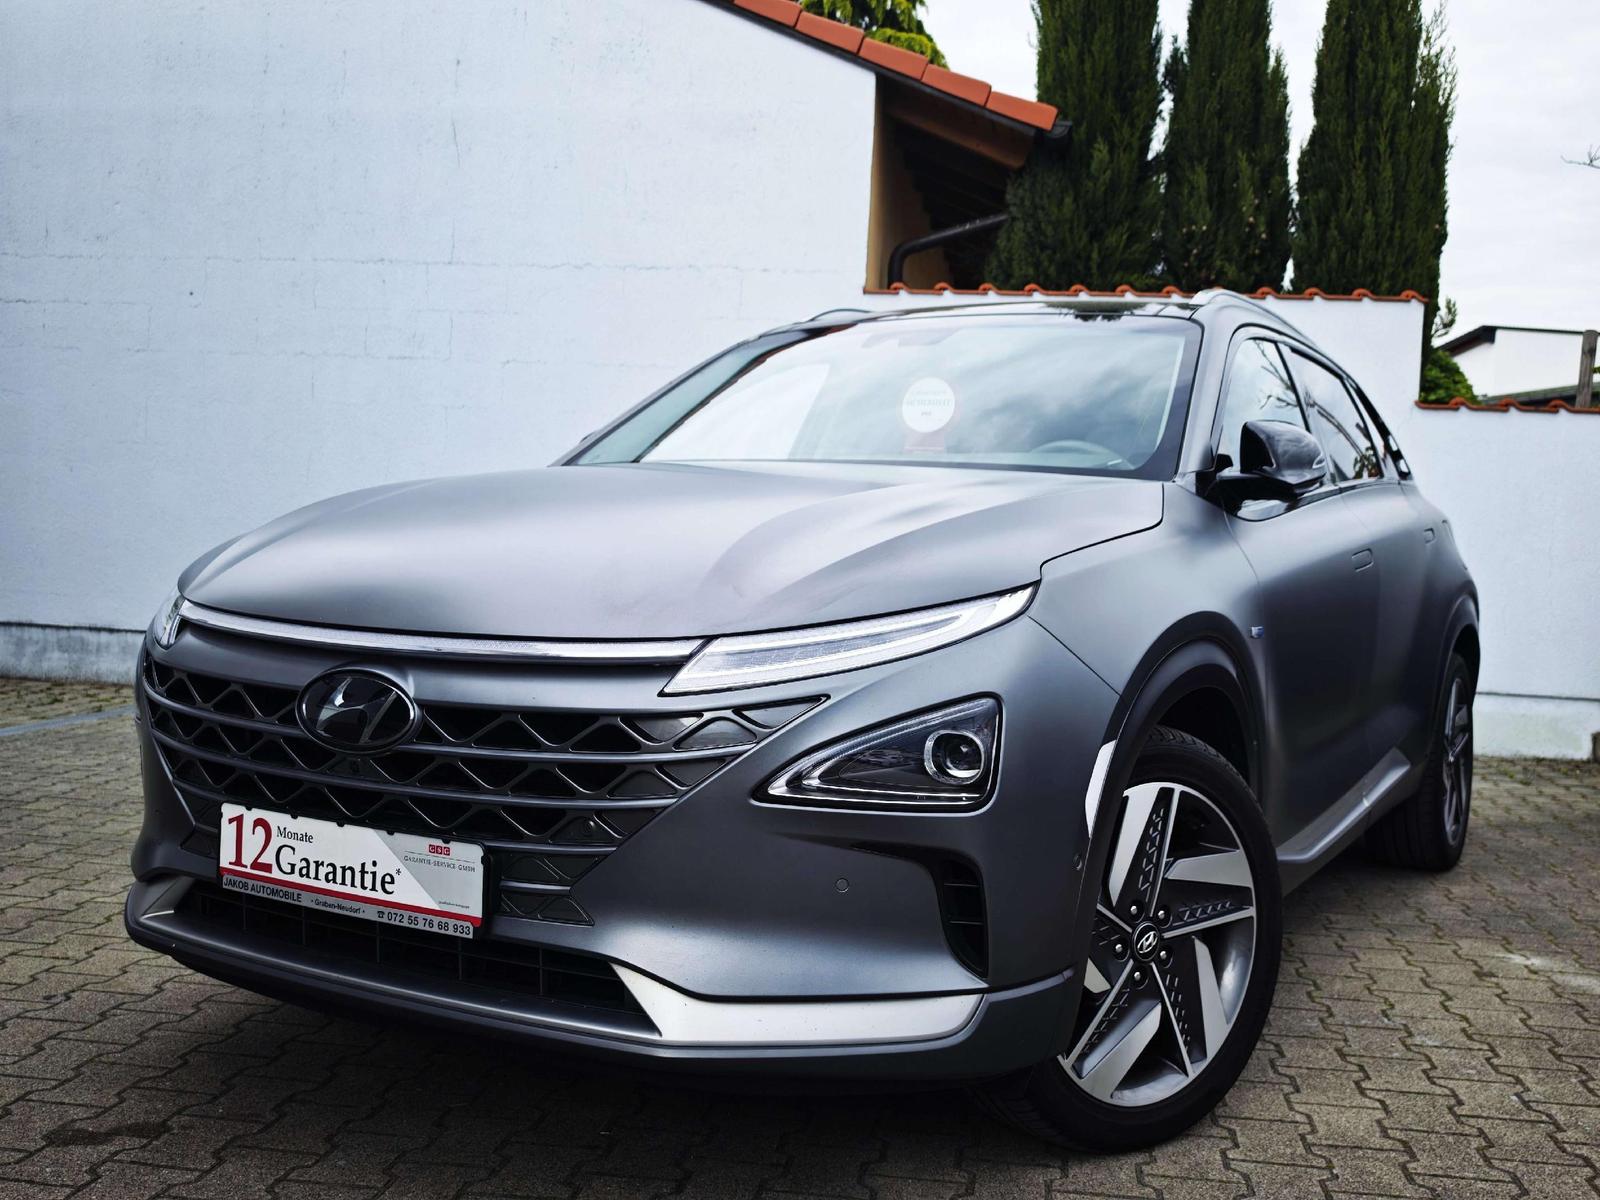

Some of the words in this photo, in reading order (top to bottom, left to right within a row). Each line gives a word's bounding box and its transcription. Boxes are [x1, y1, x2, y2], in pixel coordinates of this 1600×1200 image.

[227, 813, 273, 875] 12
[276, 825, 314, 844] Monate
[223, 878, 249, 891] JAKOB
[250, 883, 302, 903] AUTOMOBILE
[314, 898, 361, 914] Graben-Neudorf
[387, 911, 404, 923] 072
[407, 915, 419, 926] 55
[422, 917, 434, 929] 76
[437, 920, 450, 932] 68
[452, 923, 471, 936] 933
